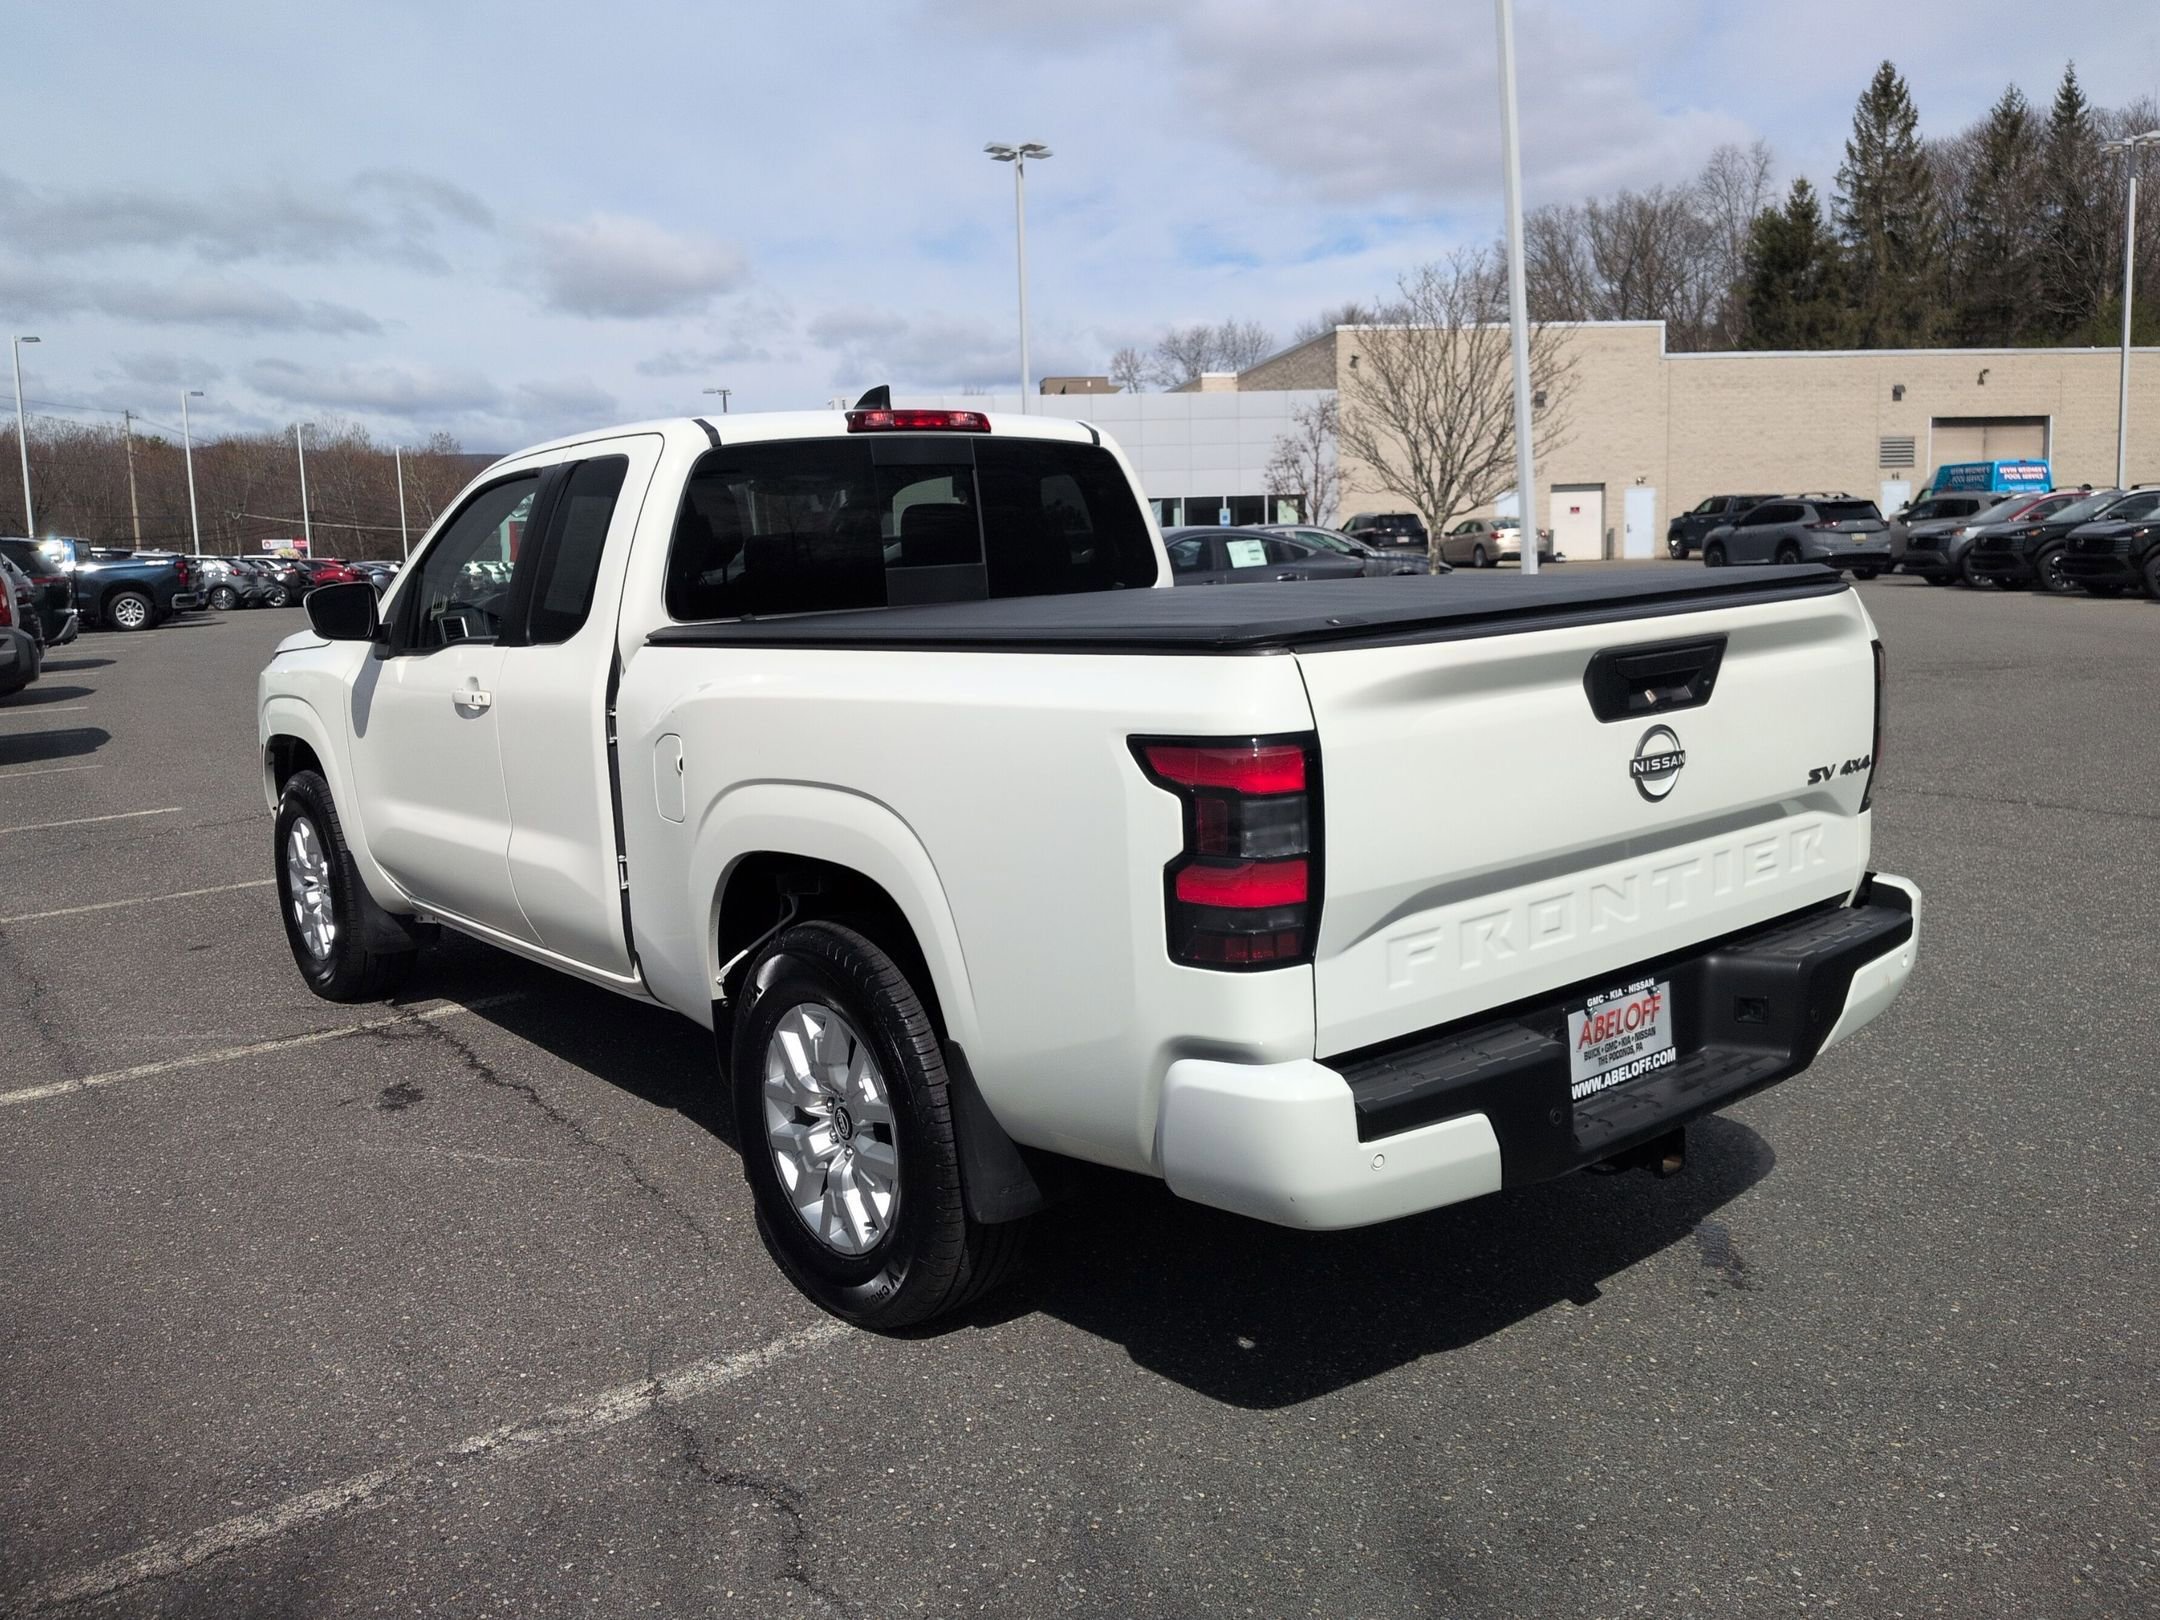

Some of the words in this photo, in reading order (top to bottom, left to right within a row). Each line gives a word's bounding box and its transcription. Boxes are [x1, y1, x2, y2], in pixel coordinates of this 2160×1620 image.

[1633, 752, 1686, 774] NISSAN
[1807, 764, 1837, 785] SV
[1386, 822, 1827, 990] FRONTIER
[1587, 994, 1605, 1008] GMC
[1609, 988, 1623, 1000] KIA
[1628, 977, 1655, 994] NISSAN
[1577, 994, 1663, 1052] ABELOFF
[1584, 1046, 1602, 1062] BUICK
[1604, 1040, 1618, 1053] GMC
[1620, 1035, 1631, 1046] KIA
[1634, 1026, 1657, 1042] NISSAN
[1598, 1054, 1609, 1066] THE
[1636, 1042, 1644, 1053] PA
[1571, 1046, 1677, 1101] WWW.ABELOFF.COM
